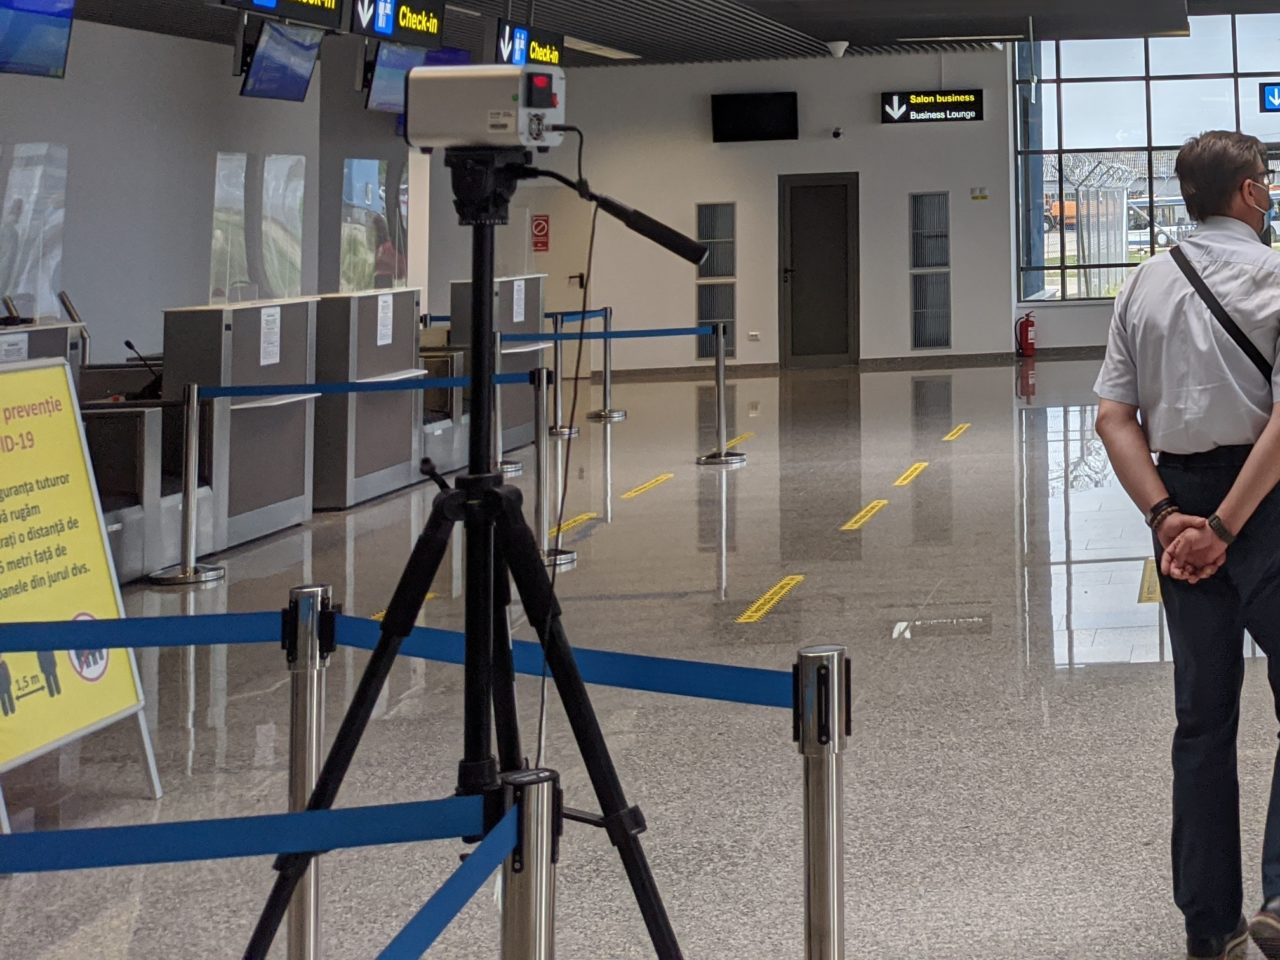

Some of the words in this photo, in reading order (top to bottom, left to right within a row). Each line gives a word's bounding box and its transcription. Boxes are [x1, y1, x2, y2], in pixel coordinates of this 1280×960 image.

[398, 4, 439, 34] Check-in
[529, 40, 560, 65] Check-in
[909, 94, 935, 104] Salon
[936, 93, 976, 103] business
[909, 111, 946, 120] Business
[946, 109, 976, 119] Lounge
[0, 430, 35, 453] ID-19
[35, 473, 70, 491] tuturor
[10, 503, 41, 522] rugăm
[18, 532, 26, 544] o
[67, 516, 80, 531] de
[6, 551, 33, 572] metri
[55, 543, 68, 557] de
[30, 574, 47, 590] din
[47, 566, 70, 588] jurul
[71, 562, 91, 577] dvs.
[15, 675, 30, 692] 1,5
